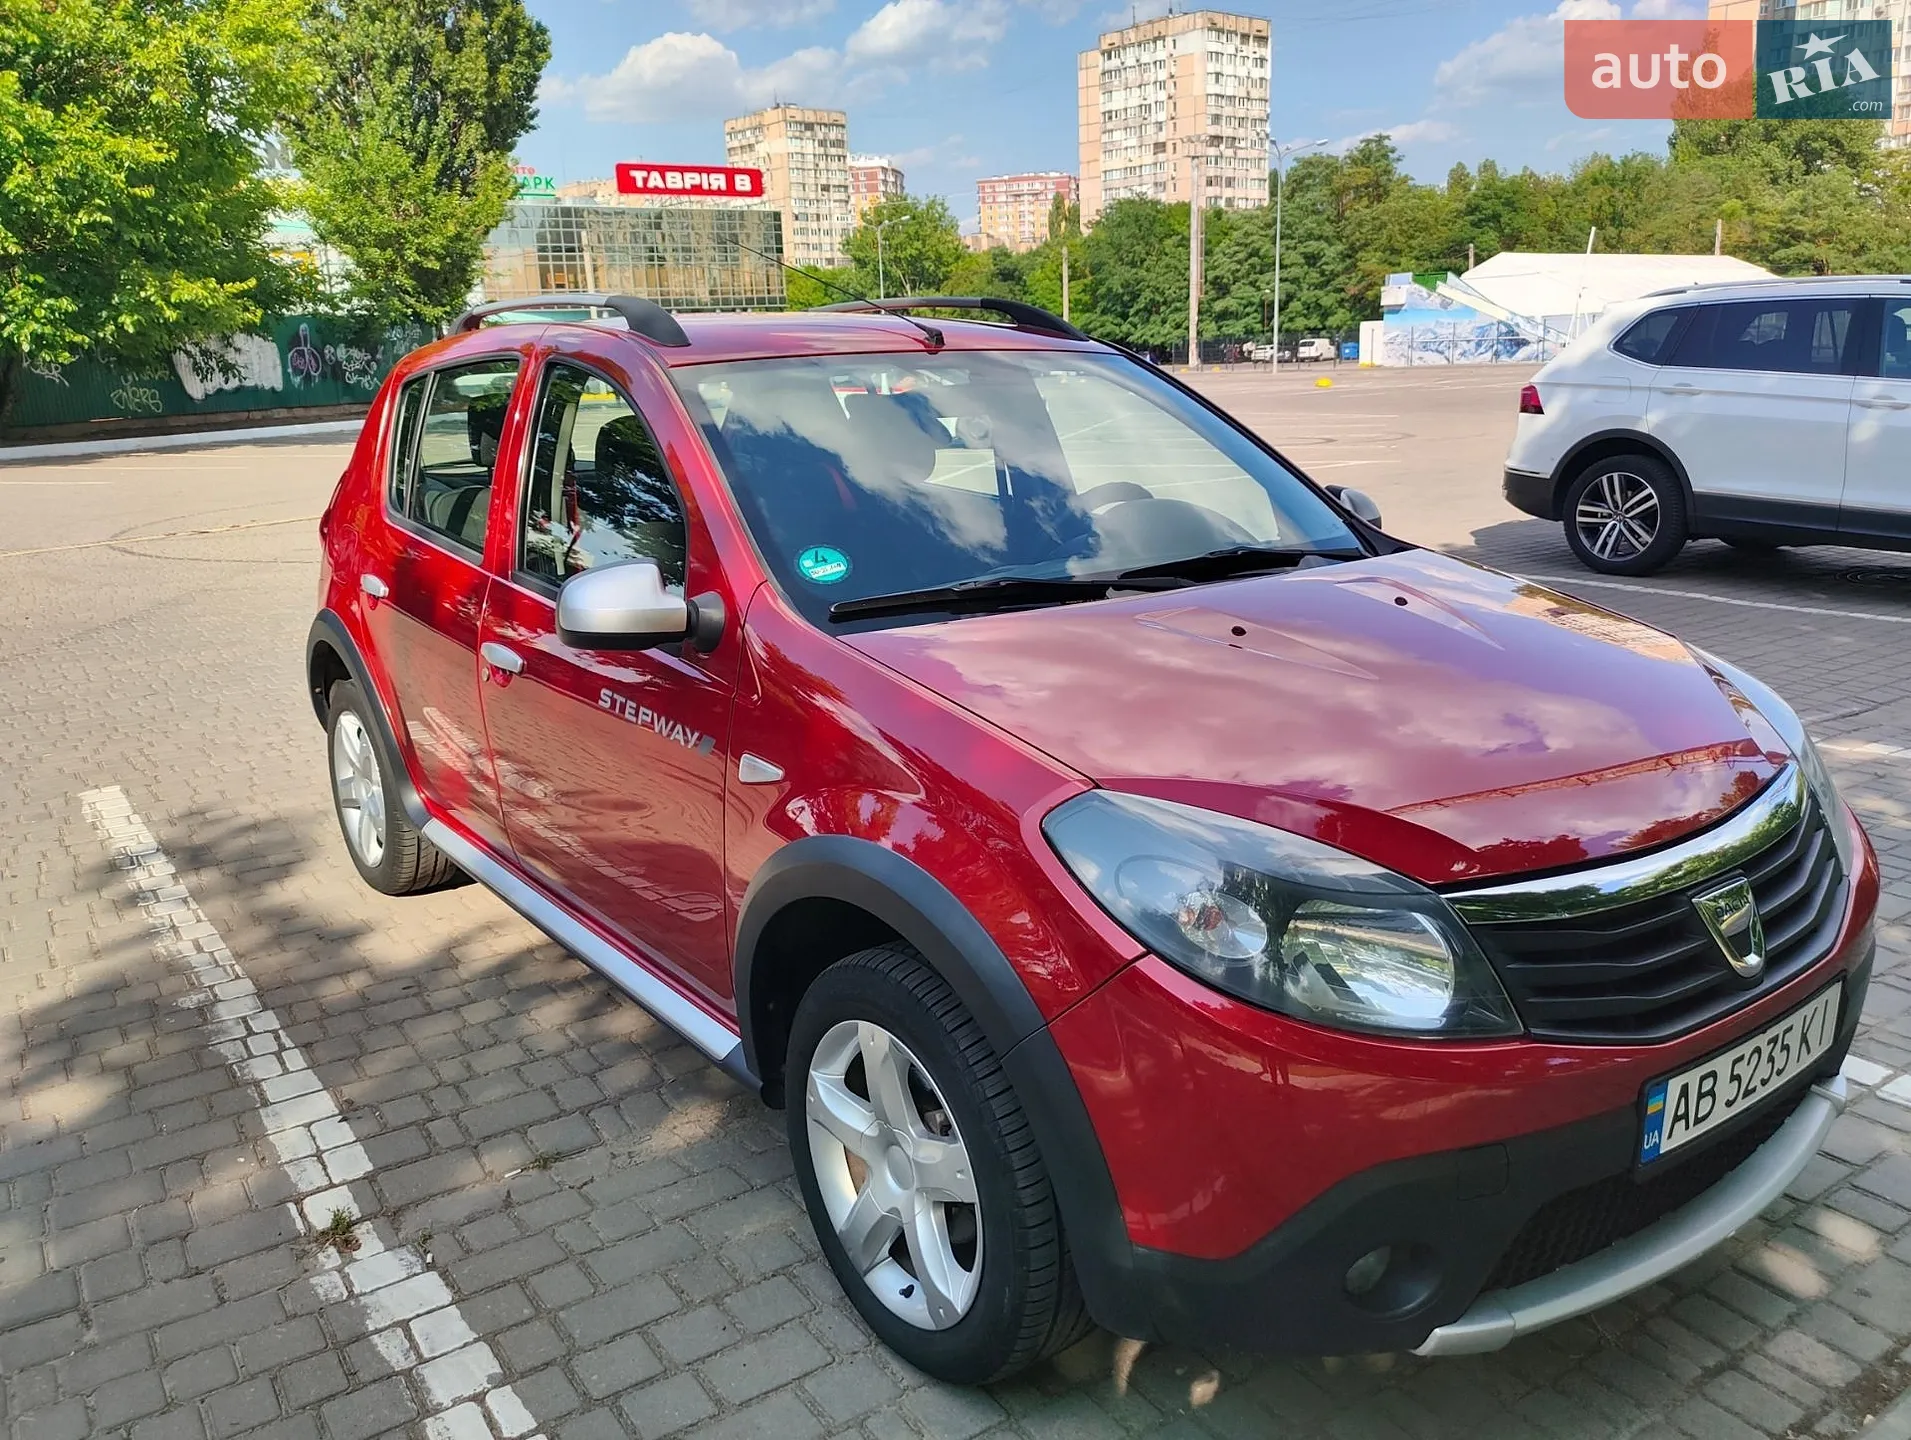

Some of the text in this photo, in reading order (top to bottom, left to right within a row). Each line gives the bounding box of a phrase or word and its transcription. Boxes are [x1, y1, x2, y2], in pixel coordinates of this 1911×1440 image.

[629, 169, 752, 192] ТАВРІЯ В
[598, 687, 700, 749] STEPWAY
[1666, 999, 1830, 1141] AB 5235 KI
[1643, 1130, 1660, 1150] UA
